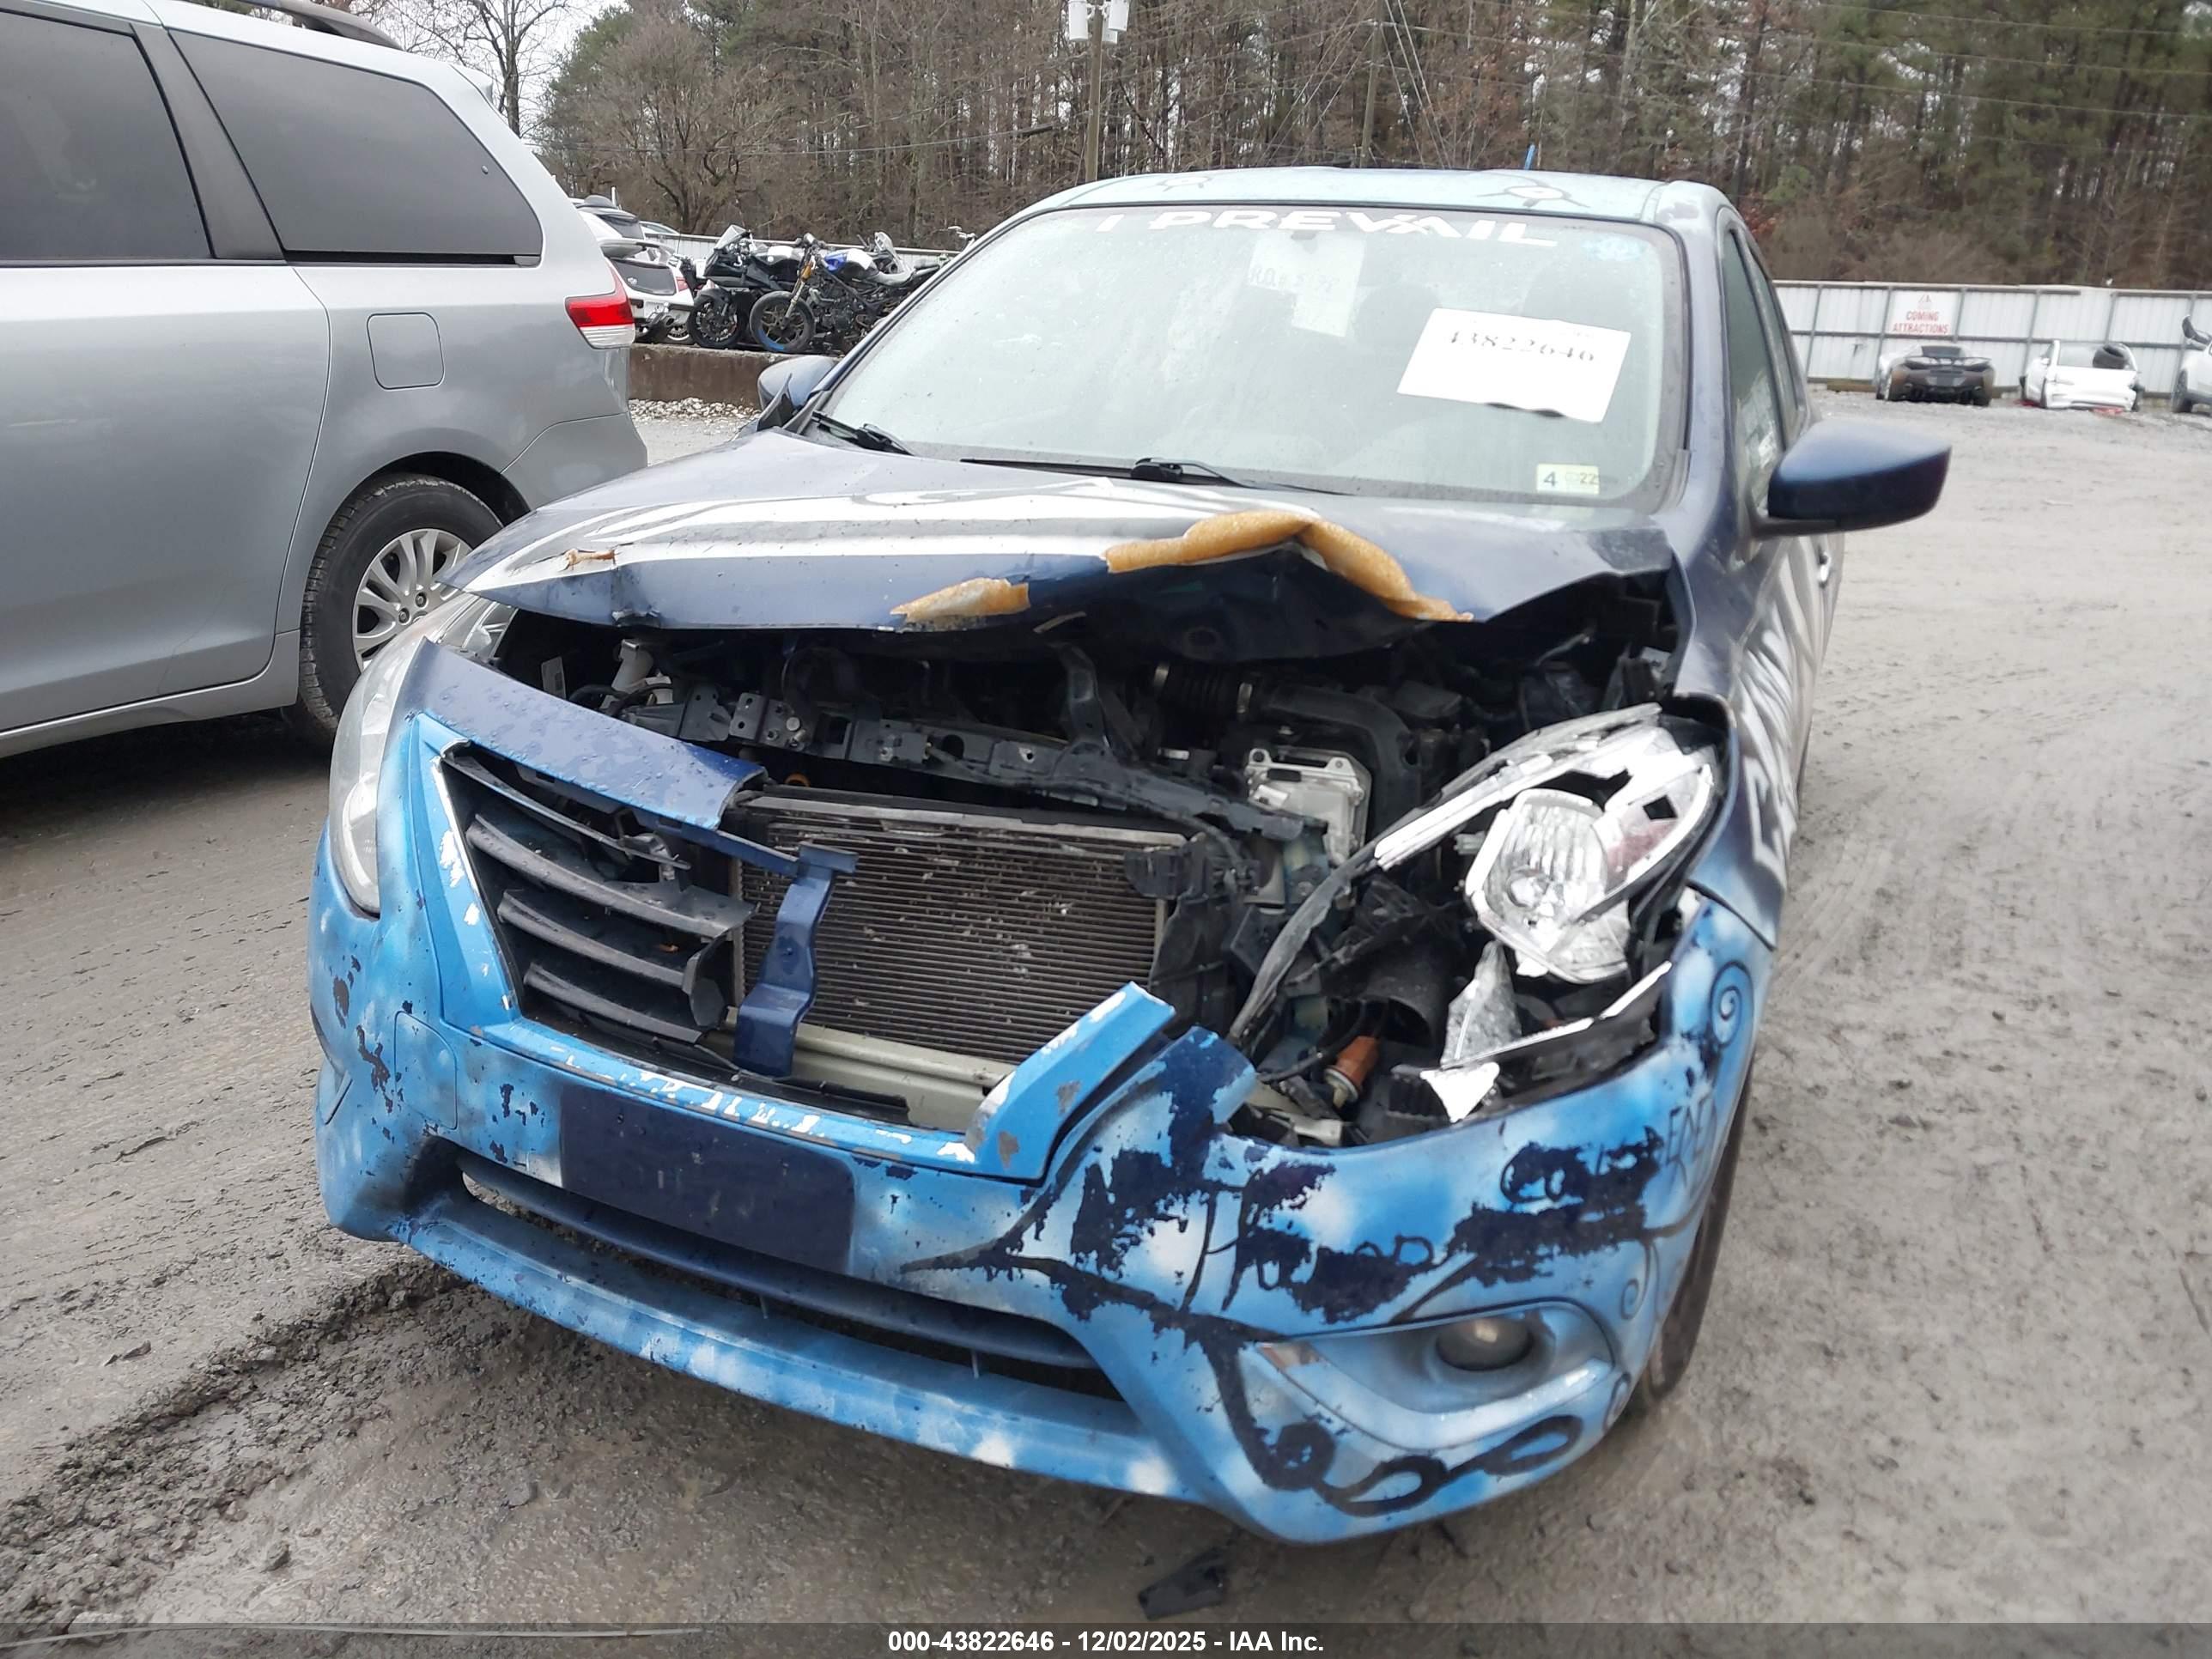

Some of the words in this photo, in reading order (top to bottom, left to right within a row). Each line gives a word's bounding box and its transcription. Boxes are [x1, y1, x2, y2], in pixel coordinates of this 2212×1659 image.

[1098, 215, 1126, 232] I
[1149, 210, 1559, 247] PREVAIL
[1905, 311, 1939, 321] COMING
[1892, 322, 1948, 335] ATTRACTIONS
[1543, 471, 1559, 487] 4
[1580, 471, 1599, 485] 22
